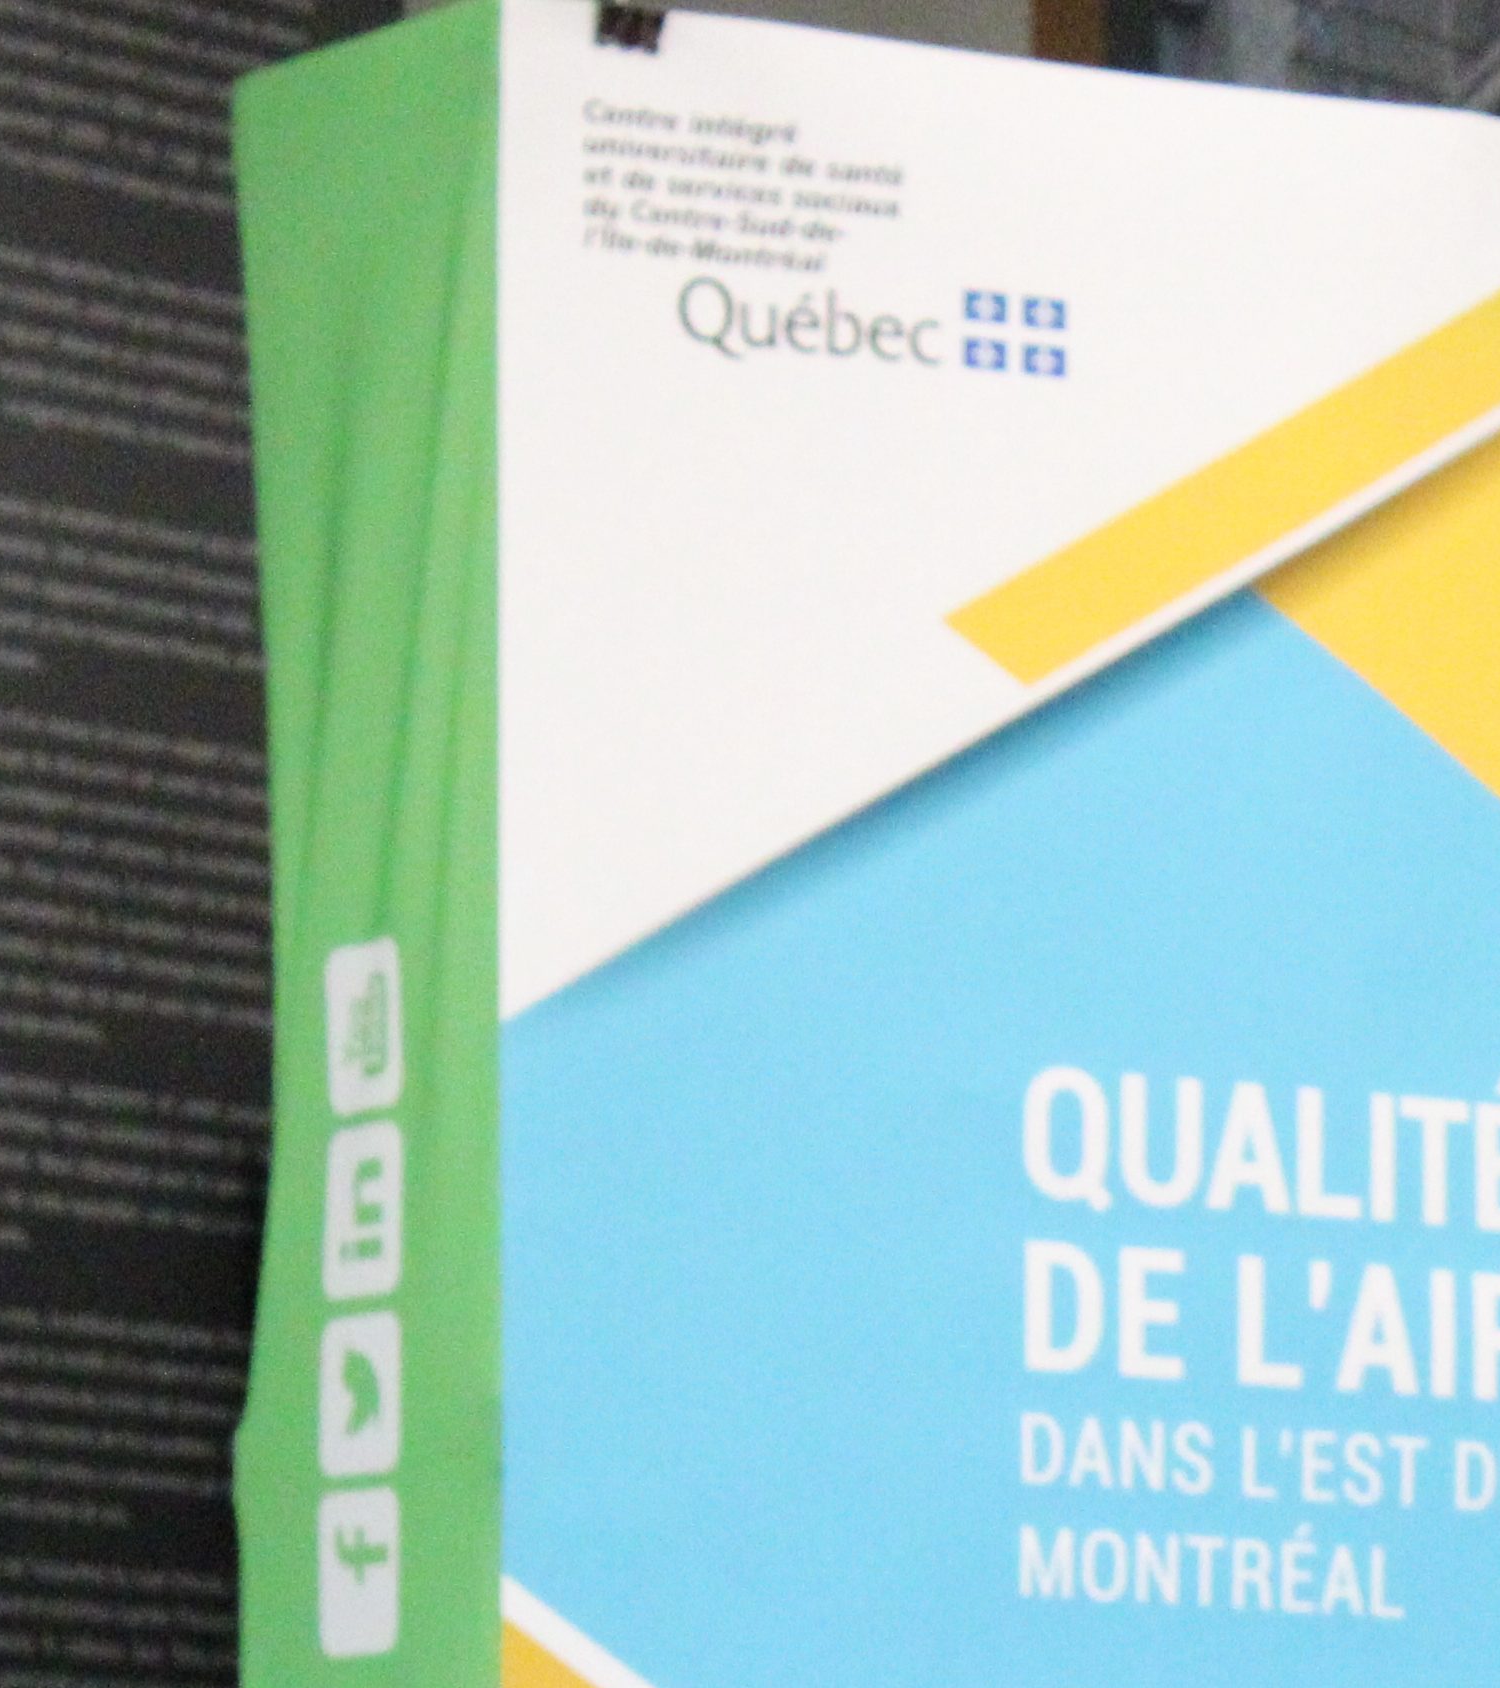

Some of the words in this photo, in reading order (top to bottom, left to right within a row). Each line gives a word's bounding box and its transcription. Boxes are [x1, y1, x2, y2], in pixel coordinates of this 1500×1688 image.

[583, 97, 678, 131] Centre
[621, 169, 656, 192] de
[779, 154, 815, 178] de
[677, 275, 942, 367] Québec
[1023, 1238, 1185, 1380] DE
[1019, 1411, 1215, 1496] DANS
[1241, 1424, 1429, 1508] L'EST
[1018, 1522, 1406, 1620] MONTRÉAL
